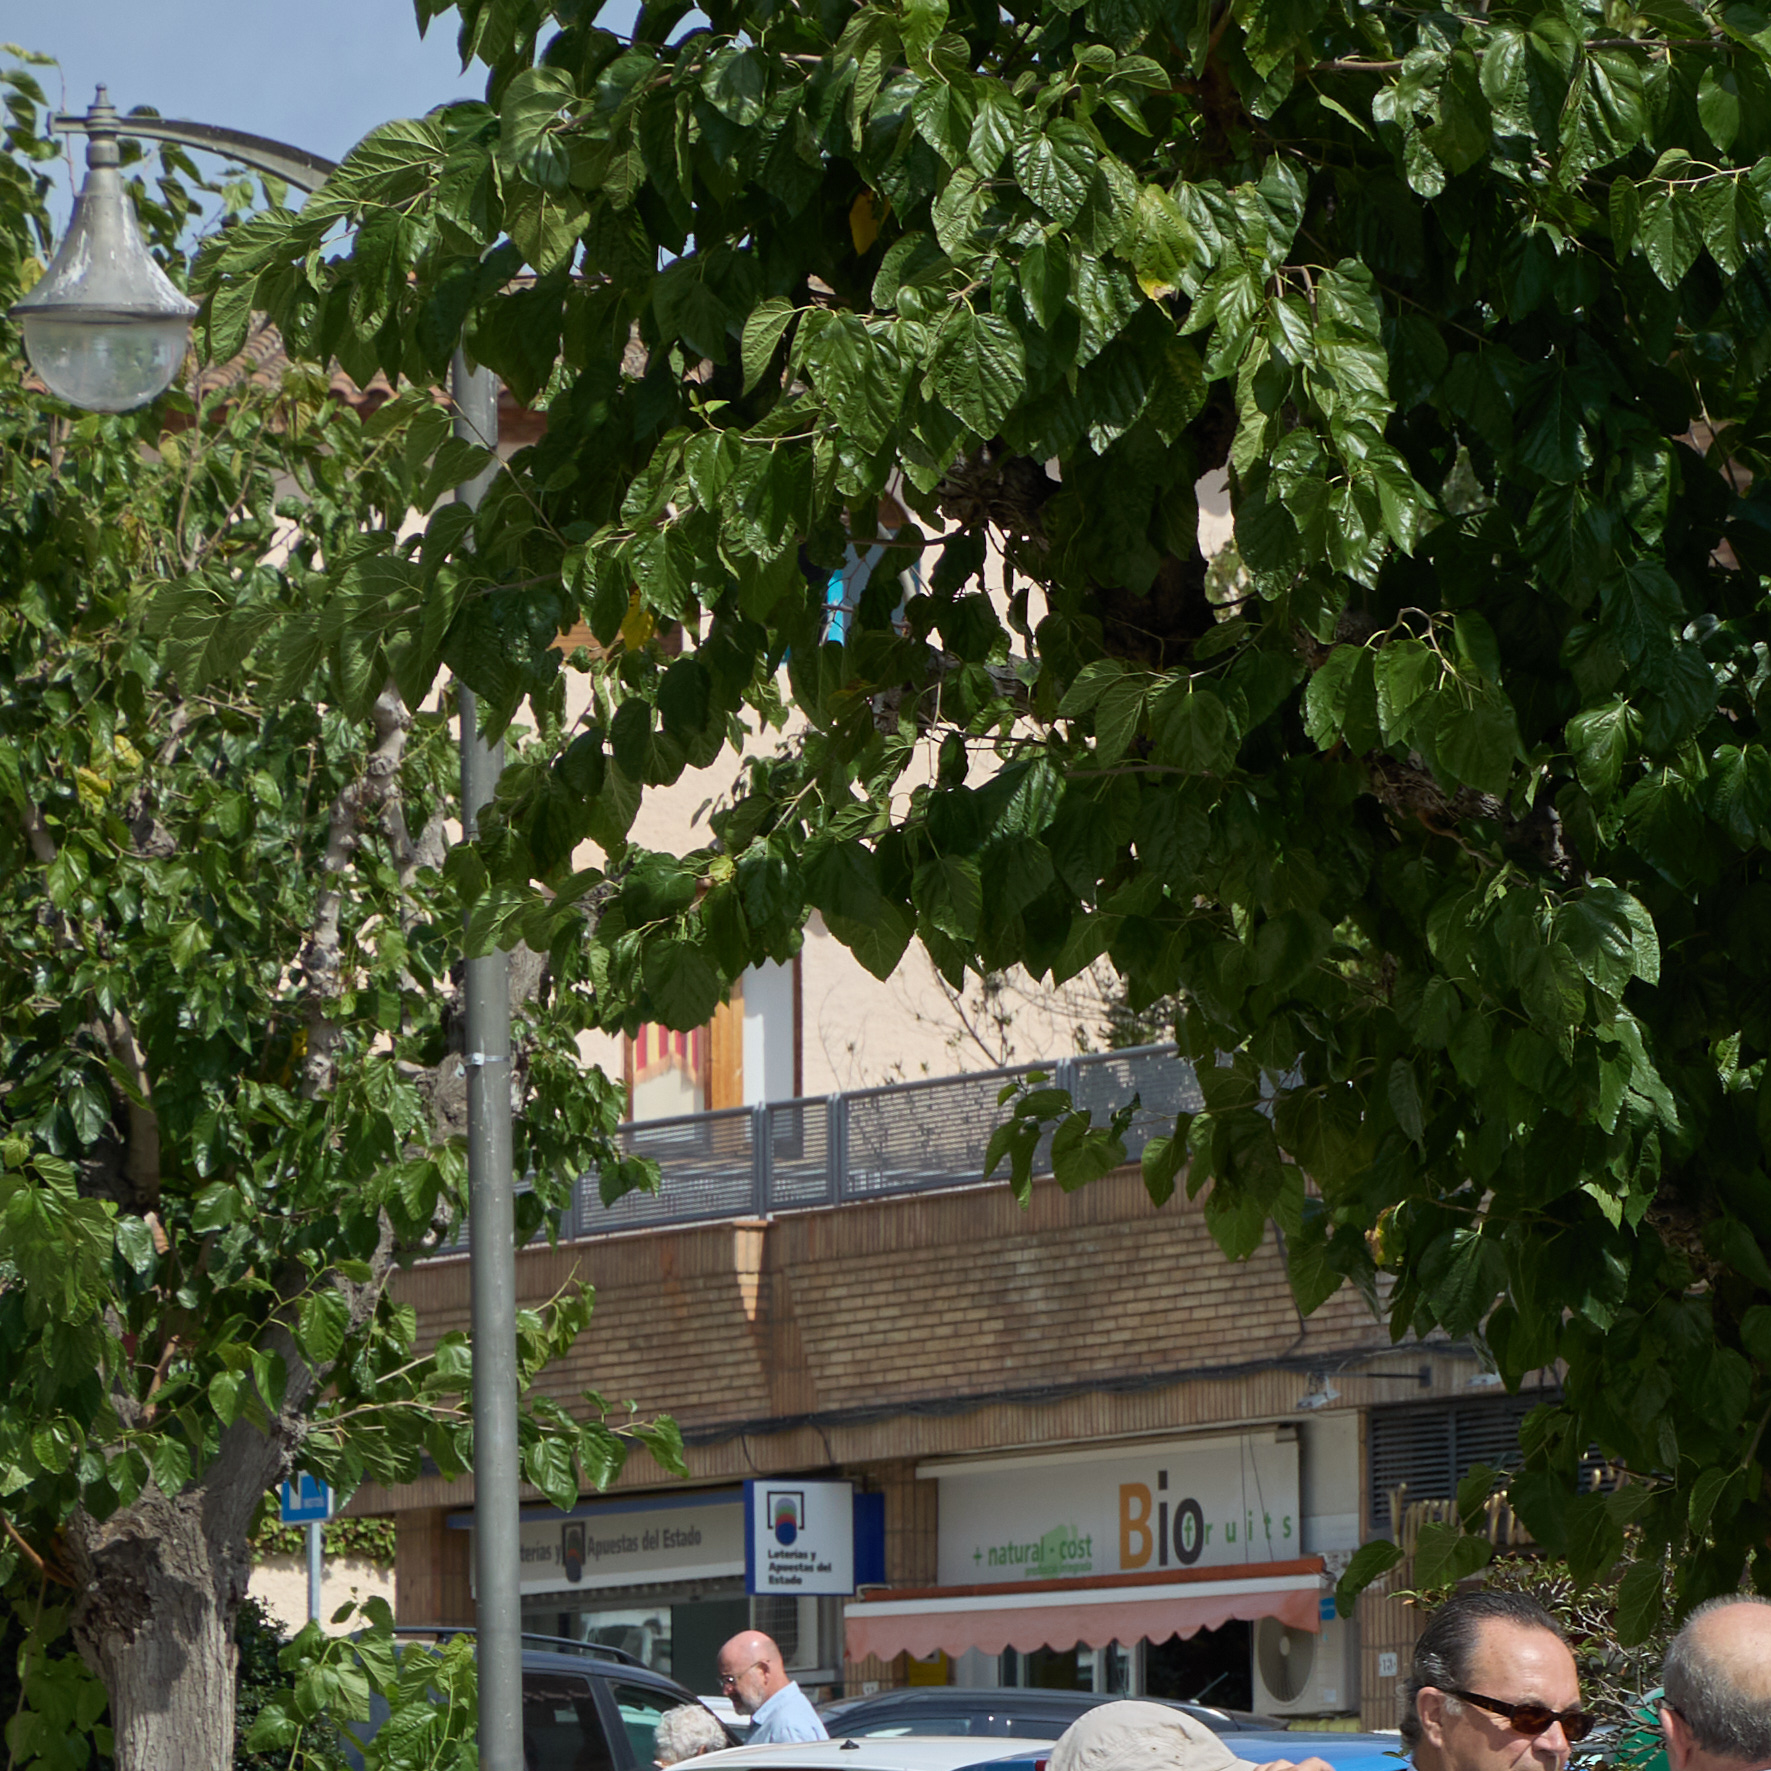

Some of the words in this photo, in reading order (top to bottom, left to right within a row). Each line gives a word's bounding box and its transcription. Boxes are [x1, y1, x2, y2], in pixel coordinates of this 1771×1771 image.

[1119, 1470, 1204, 1571] Bio
[1183, 1511, 1293, 1548] fruits
[520, 1541, 552, 1563] terías
[555, 1545, 563, 1566] y
[587, 1533, 639, 1562] Apuestas
[642, 1529, 660, 1550] del
[663, 1525, 702, 1549] Estado
[810, 1551, 817, 1562] y
[988, 1535, 1045, 1567] natural
[1059, 1533, 1093, 1561] cost
[768, 1562, 814, 1574] Apuestas
[816, 1561, 832, 1573] del
[768, 1574, 803, 1585] Estado
